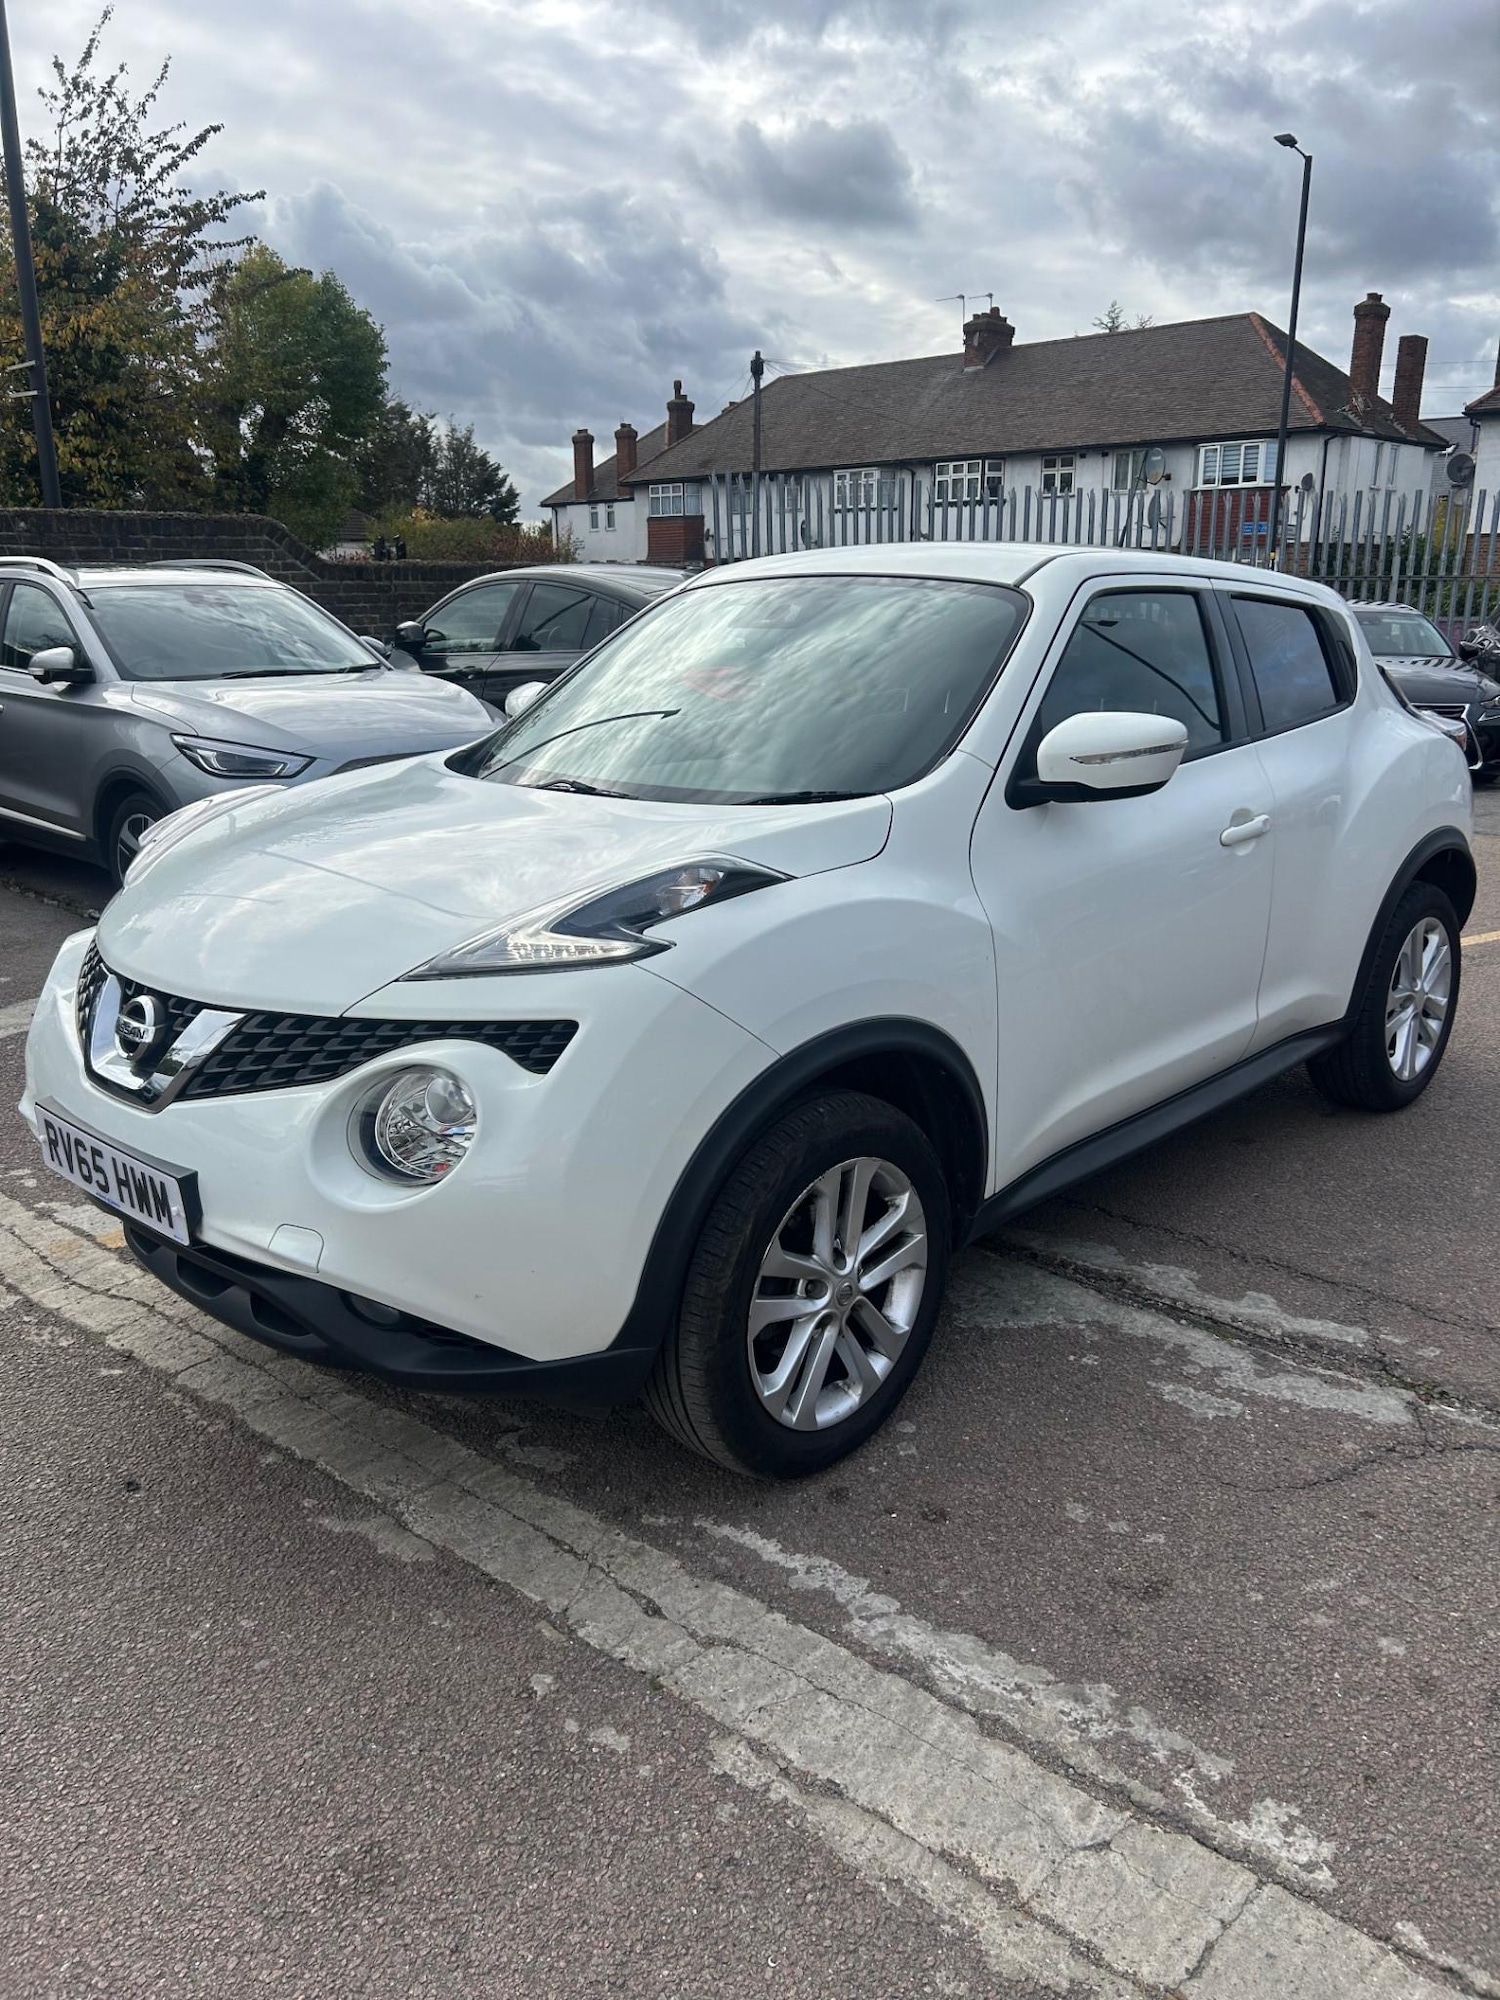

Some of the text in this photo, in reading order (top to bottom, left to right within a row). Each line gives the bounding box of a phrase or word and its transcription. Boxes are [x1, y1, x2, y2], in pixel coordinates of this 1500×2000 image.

[117, 1019, 146, 1040] SSAN
[44, 1118, 174, 1229] RV65 HWM
